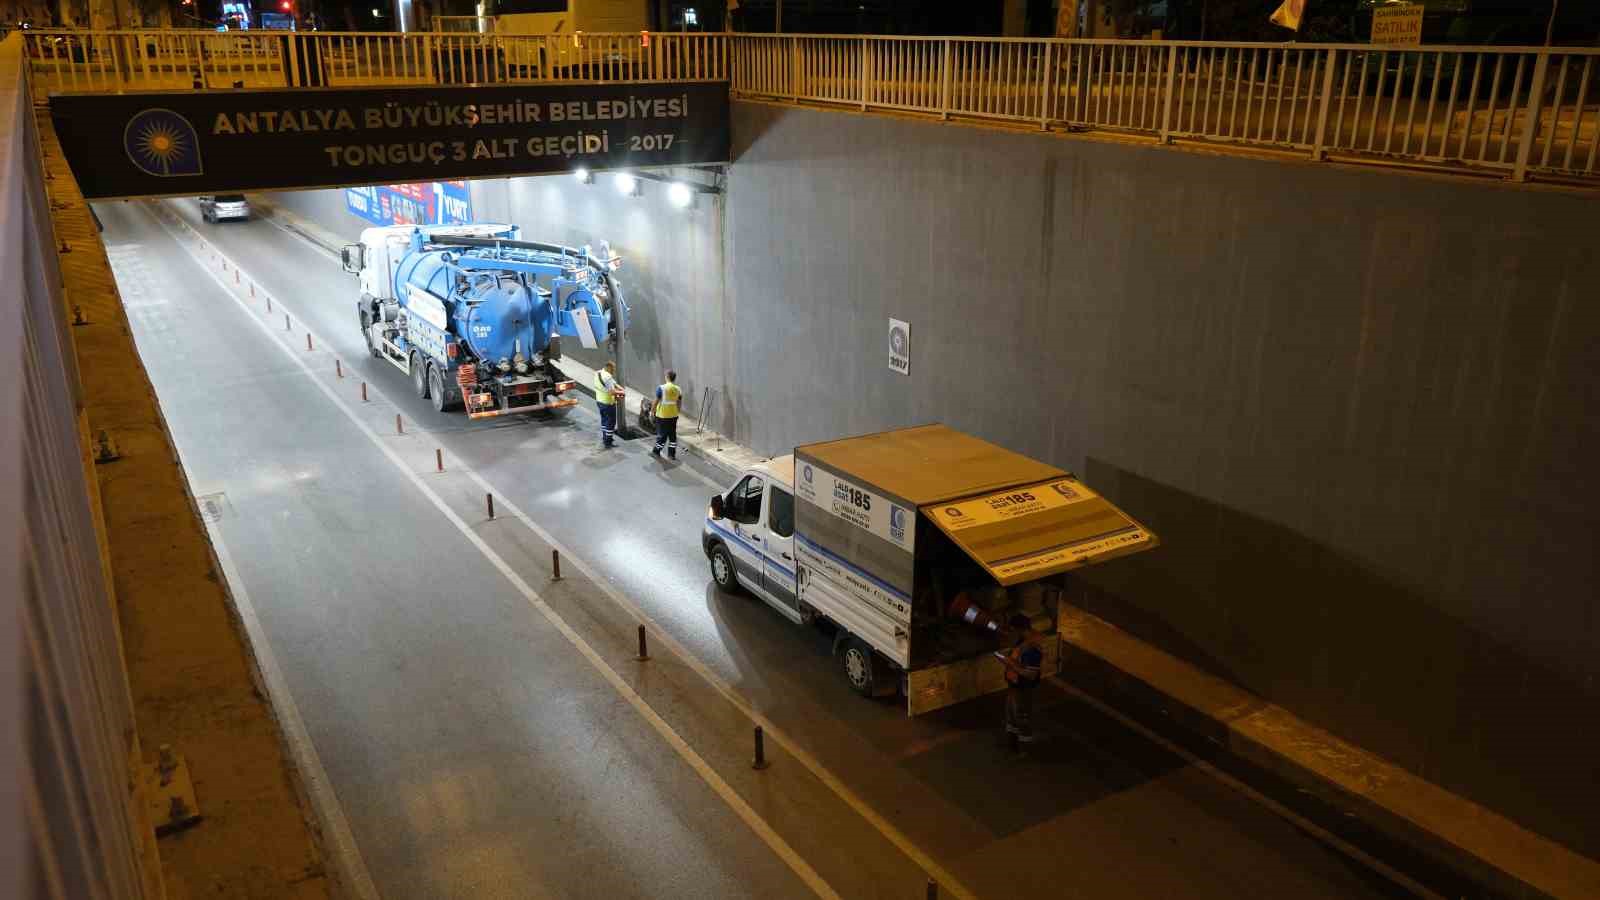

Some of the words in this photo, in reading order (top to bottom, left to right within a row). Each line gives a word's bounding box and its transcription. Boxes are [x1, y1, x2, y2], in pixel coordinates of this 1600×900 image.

[213, 108, 355, 135] ANTALYA
[364, 99, 541, 128] BÜYÜKŞEHİR
[549, 94, 689, 122] BELEDİYESİ
[325, 140, 449, 167] TONGUÇ
[453, 141, 466, 161] 3
[472, 139, 519, 160] ALT
[527, 130, 610, 159] GEÇİDİ
[630, 134, 674, 152] 2017
[443, 193, 468, 221] YURT
[889, 356, 907, 369] 2017
[849, 487, 872, 511] 185
[1006, 492, 1036, 504] 185
